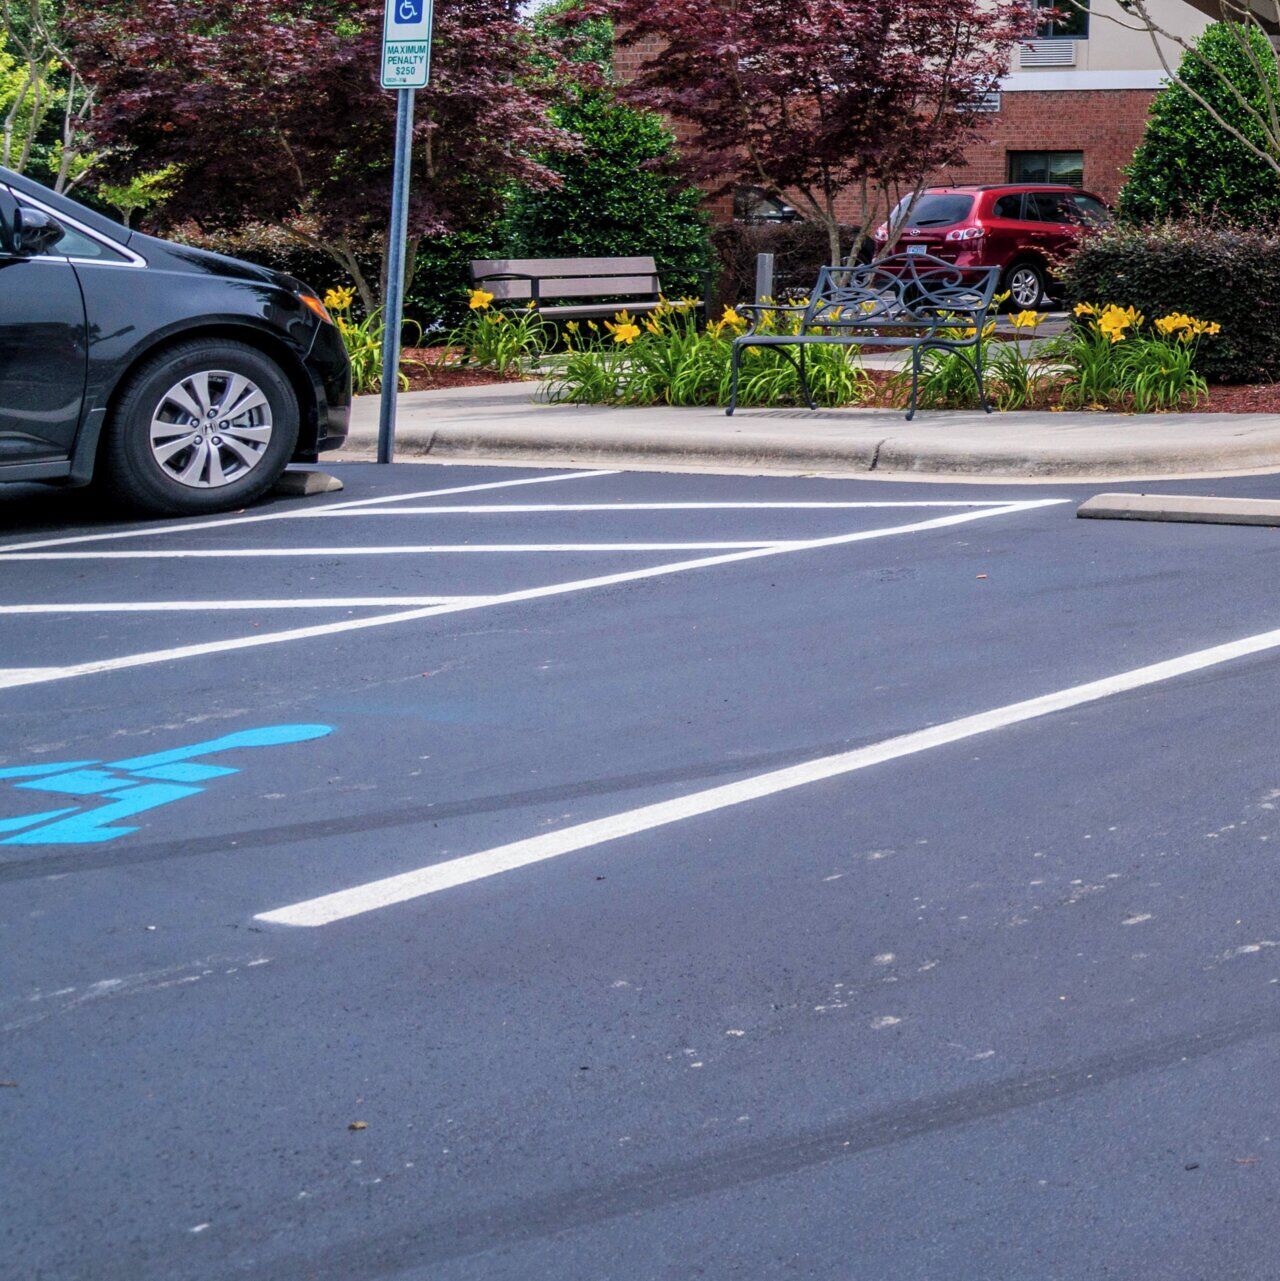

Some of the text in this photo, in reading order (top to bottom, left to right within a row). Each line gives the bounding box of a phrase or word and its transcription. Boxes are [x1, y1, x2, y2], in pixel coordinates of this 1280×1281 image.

[387, 45, 426, 55] MAXIMUM
[387, 55, 425, 65] PENALTY
[395, 66, 416, 76] $250
